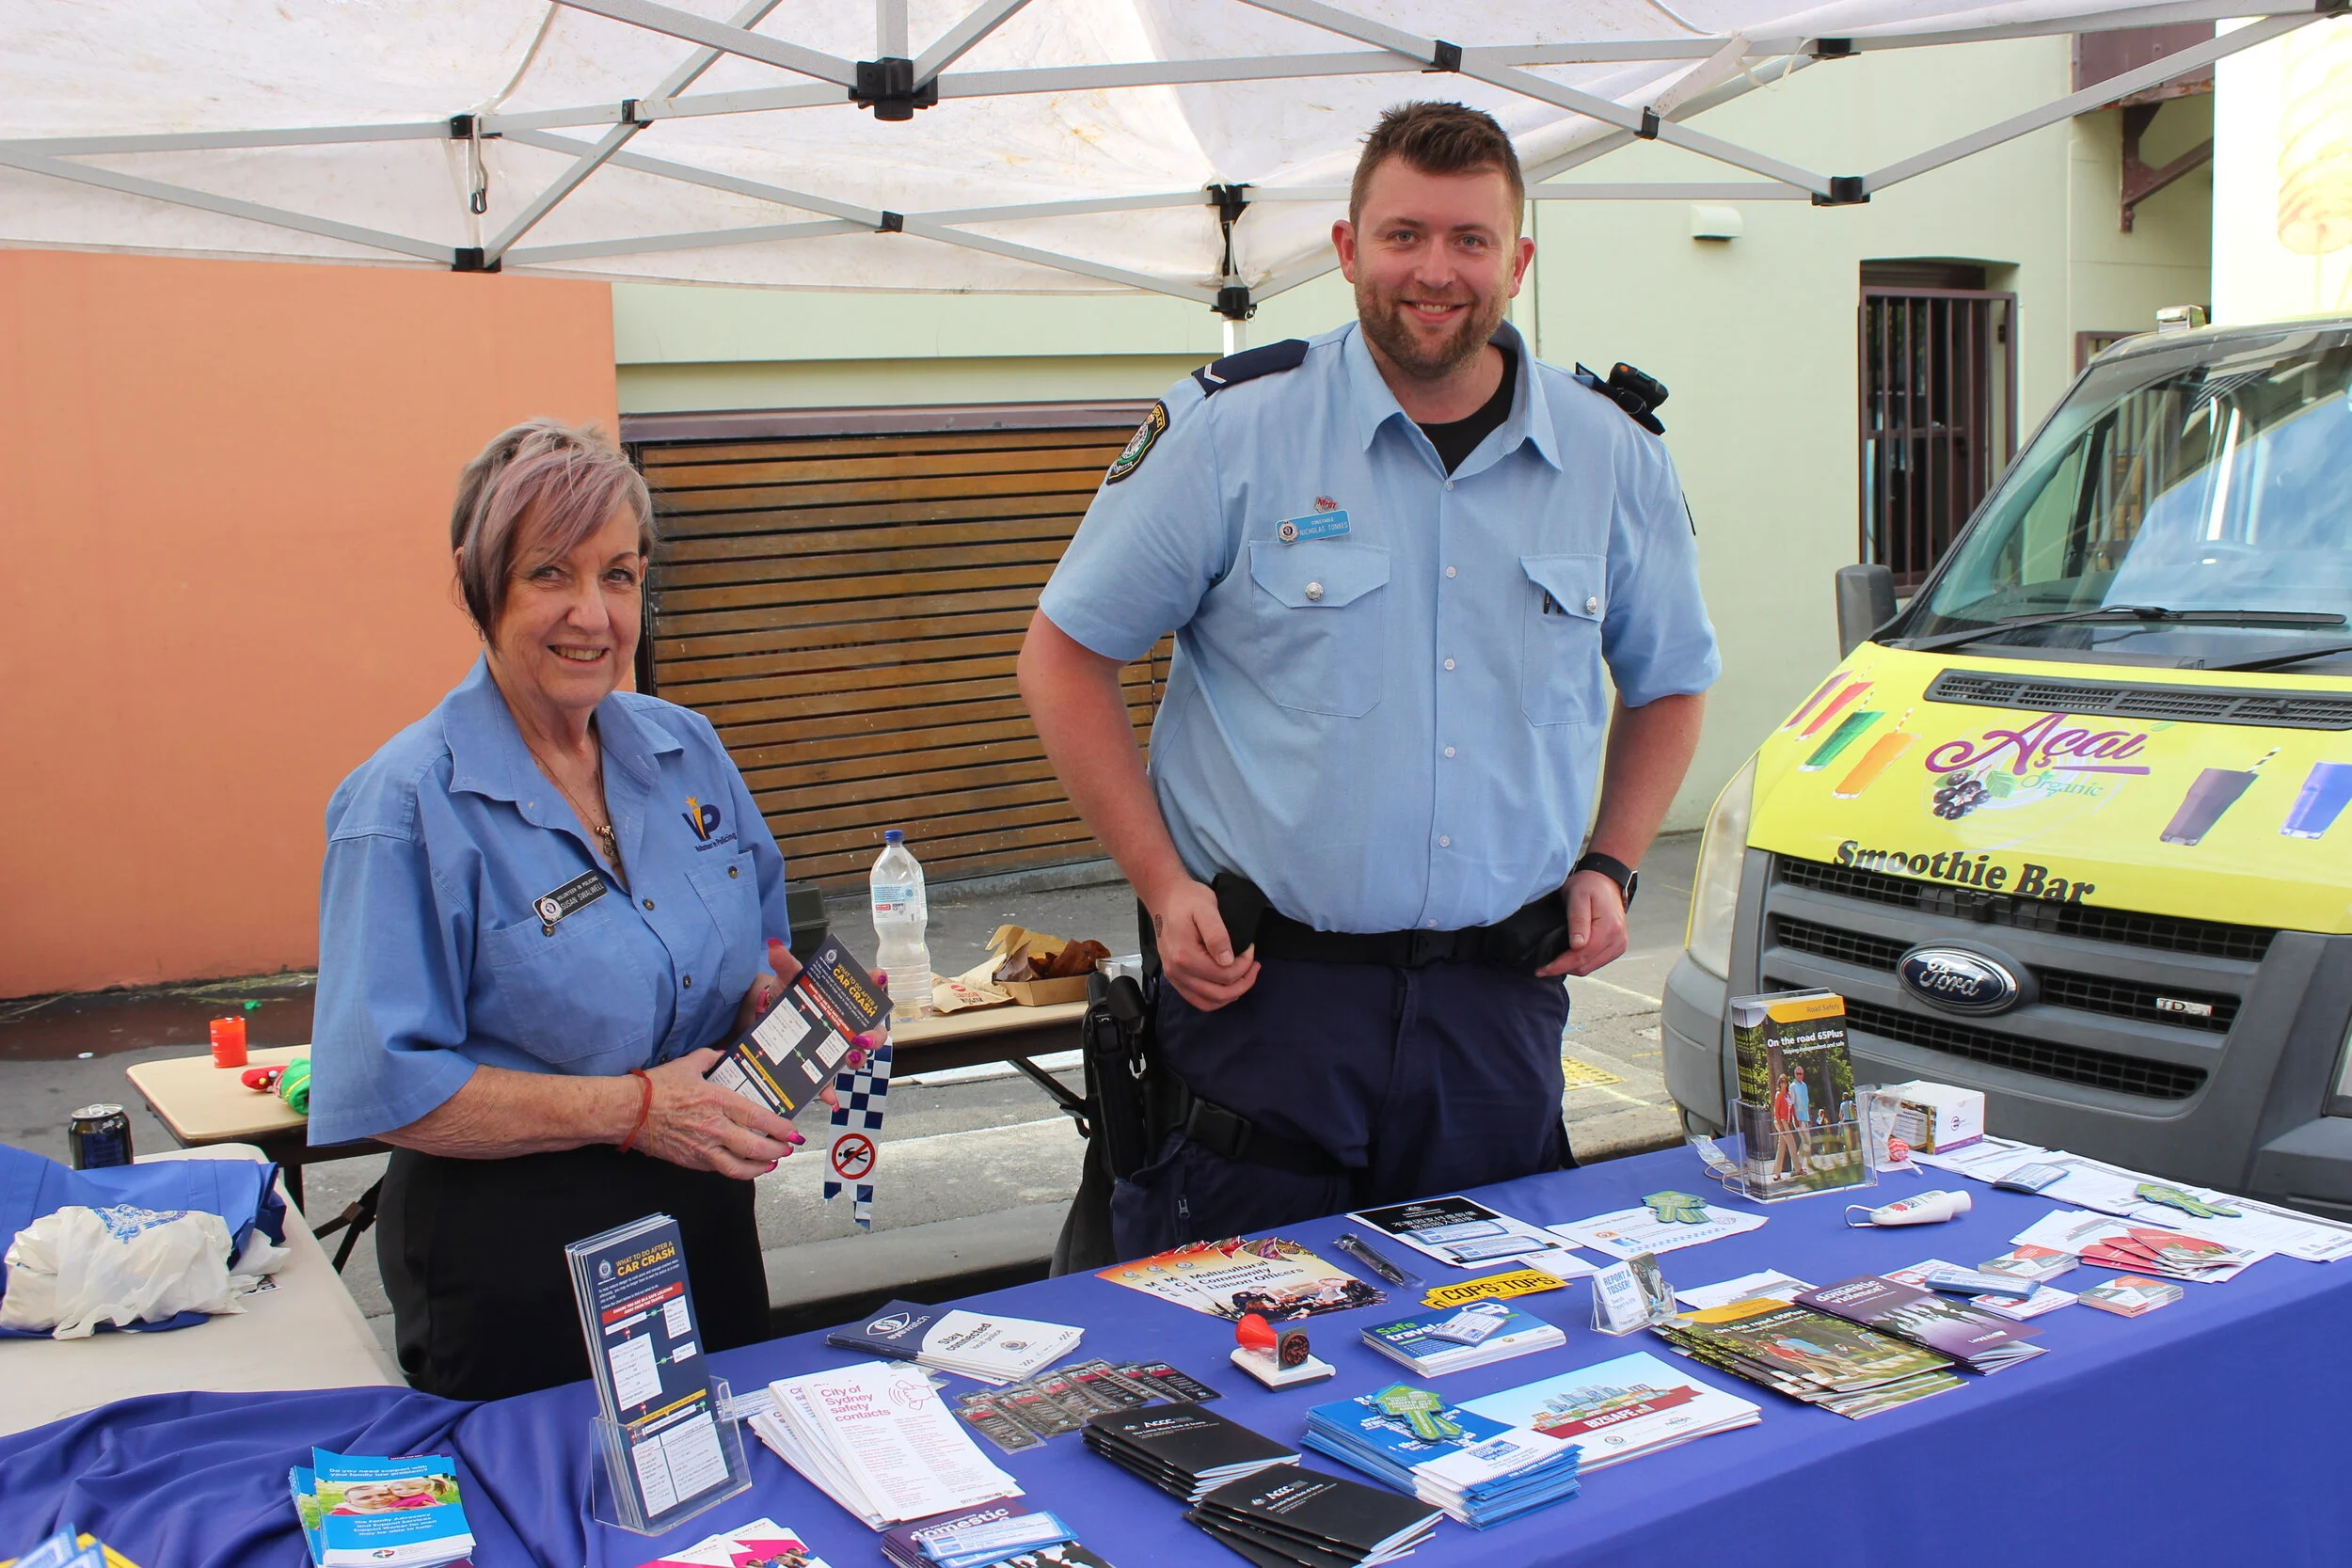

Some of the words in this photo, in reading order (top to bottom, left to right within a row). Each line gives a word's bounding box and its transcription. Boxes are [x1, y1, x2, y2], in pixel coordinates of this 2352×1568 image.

[1299, 525, 1326, 536] NICHOLAS
[1327, 521, 1348, 531] TONKES
[2021, 771, 2104, 798] Organic
[1833, 839, 2008, 889] Smoothie
[2013, 863, 2095, 902] Bar
[561, 896, 579, 911] SUSAN
[579, 882, 604, 899] SWALWELL
[837, 962, 850, 978] WHAT
[860, 988, 874, 1006] AFTER
[1919, 956, 1979, 997] Ford
[833, 967, 850, 989] CAR
[849, 988, 877, 1019] CRASH
[1806, 1005, 1821, 1014] Road
[1821, 1003, 1841, 1014] Safety
[1767, 1037, 1780, 1048] On
[1780, 1036, 1795, 1047] the
[1796, 1033, 1817, 1045] road
[1817, 1029, 1844, 1042] 65Plus
[615, 1256, 632, 1267] WHAT
[641, 1249, 650, 1258] DO
[650, 1243, 668, 1255] AFTER
[617, 1260, 640, 1276] CAR
[641, 1246, 675, 1267] CRASH
[1188, 1259, 1269, 1279] Multicultural
[1198, 1267, 1271, 1286] Community
[1206, 1276, 1249, 1291] Liaison
[1249, 1266, 1305, 1285] Officers
[1602, 1270, 1625, 1287] REPORT
[1441, 1282, 1499, 1300] COPS
[1606, 1279, 1632, 1296] TOSSER!
[1815, 1279, 1880, 1303] domestic
[1830, 1285, 1888, 1305] violence?
[886, 1315, 930, 1339] eyewatch
[945, 1323, 993, 1351] connected
[1375, 1321, 1417, 1336] Safe
[937, 1331, 963, 1345] Stay
[820, 1387, 846, 1398] City
[849, 1385, 861, 1393] of
[825, 1393, 873, 1406] Sydney
[830, 1402, 869, 1414] safety
[835, 1408, 891, 1422] contacts
[1143, 1418, 1176, 1428] ACCC
[1582, 1409, 1638, 1429] BIZSAFE
[1265, 1485, 1295, 1500] ACCC
[910, 1508, 1009, 1541] domestic
